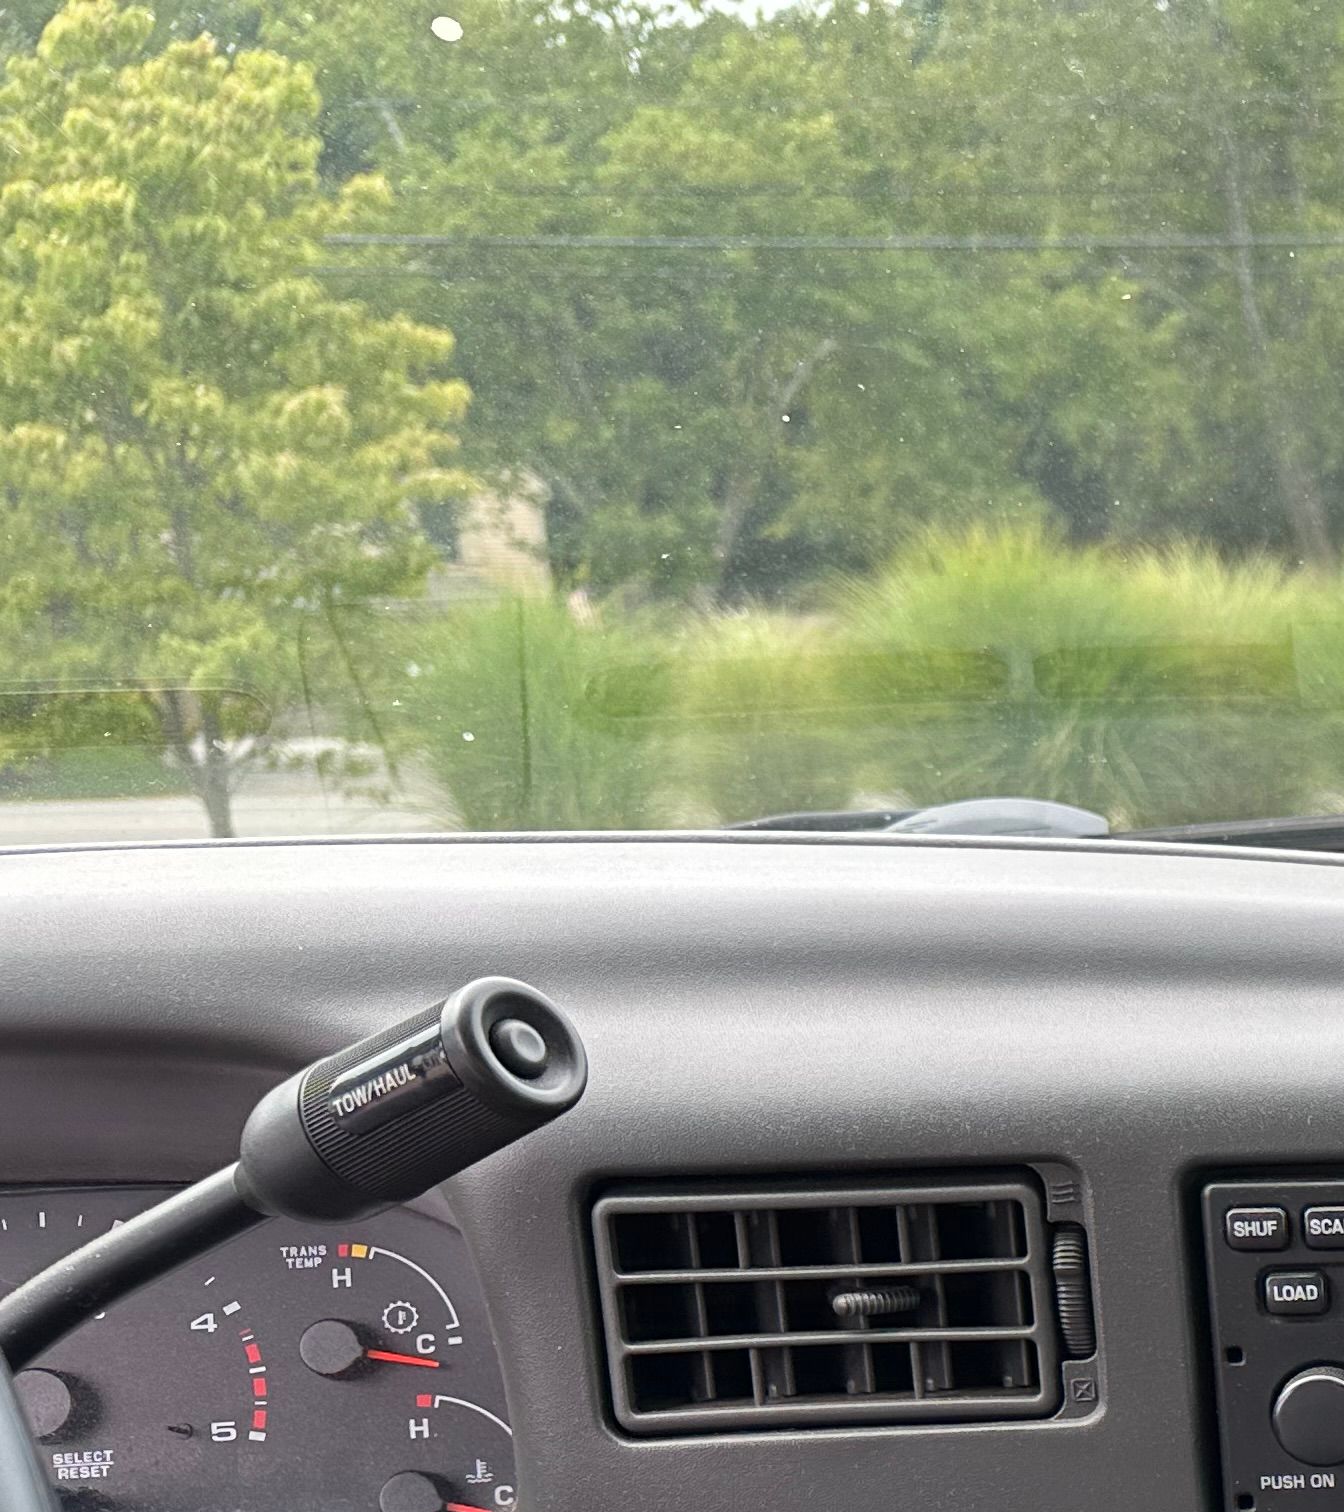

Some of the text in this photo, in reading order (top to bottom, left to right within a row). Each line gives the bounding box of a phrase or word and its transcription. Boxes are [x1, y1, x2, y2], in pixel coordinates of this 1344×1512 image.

[332, 1062, 417, 1117] TOW/HAUL
[1234, 1220, 1277, 1236] SHUF
[280, 1245, 327, 1257] TRANS
[286, 1257, 322, 1269] TEMP
[331, 1268, 351, 1288] H
[1273, 1286, 1318, 1301] LOAD
[190, 1313, 218, 1332] 4
[416, 1334, 435, 1354] C
[211, 1421, 237, 1441] 5
[409, 1418, 429, 1439] H
[53, 1450, 114, 1464] SELECT
[57, 1465, 110, 1479] RESET
[1260, 1473, 1335, 1490] PUSH ON
[494, 1486, 514, 1505] C
